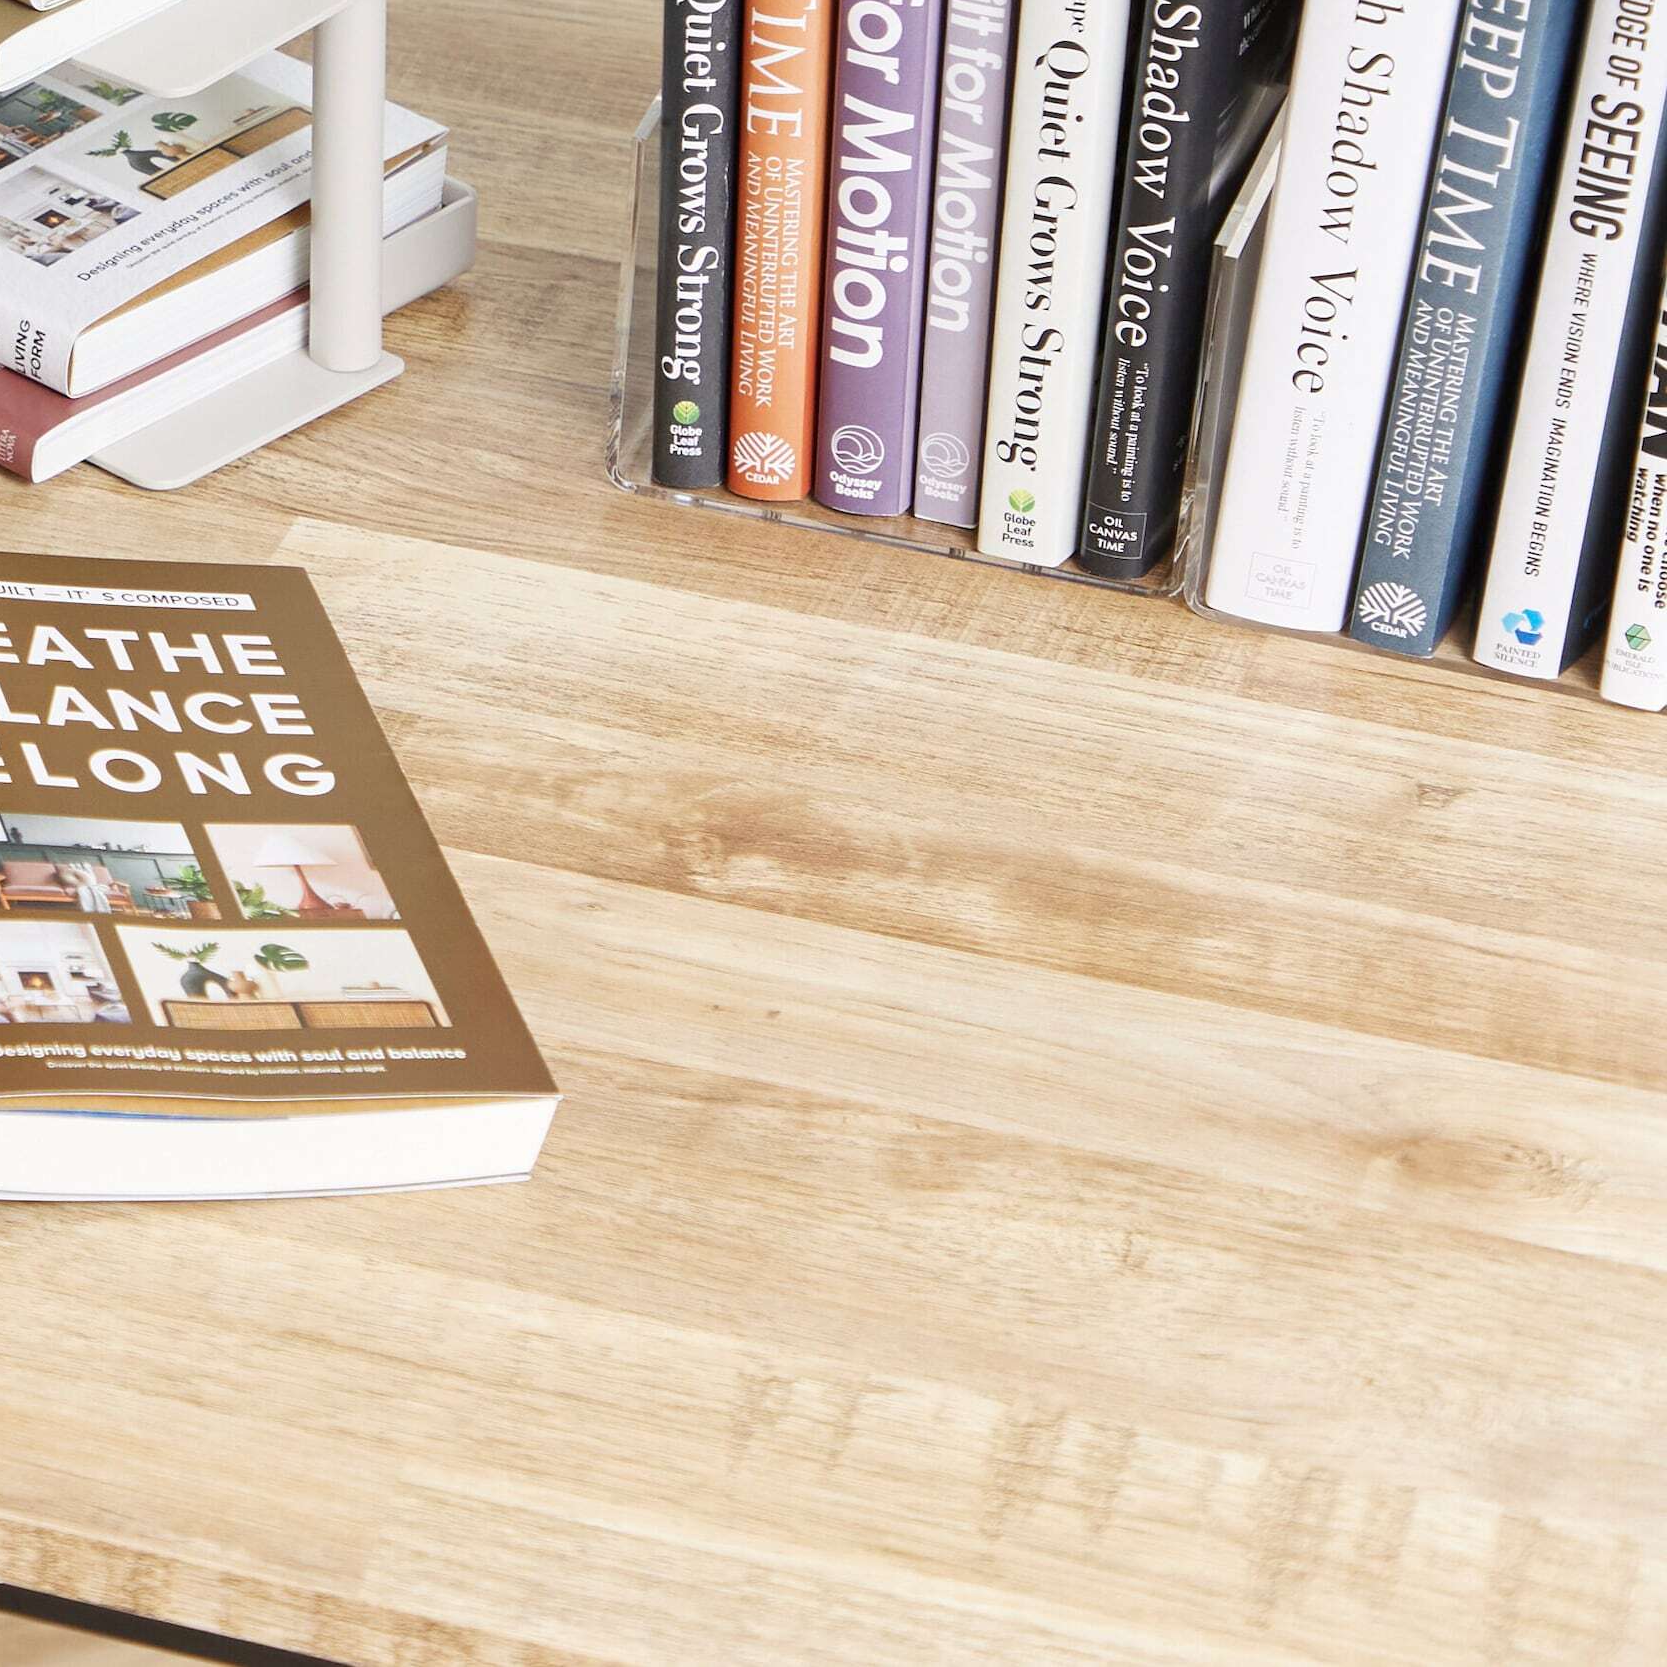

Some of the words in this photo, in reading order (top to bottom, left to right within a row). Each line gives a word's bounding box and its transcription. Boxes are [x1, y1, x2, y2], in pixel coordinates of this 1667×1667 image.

[942, 45, 1003, 126] for
[1606, 53, 1647, 92] OF
[1035, 40, 1092, 162] Quiet
[677, 102, 725, 233] Grows
[765, 156, 782, 182] OF
[1319, 44, 1398, 245] Shadow
[1570, 93, 1646, 242] SEEING
[747, 150, 762, 196] AND
[781, 158, 804, 267] MASTERING
[1418, 116, 1521, 295] TIME
[829, 93, 915, 368] Motion
[929, 129, 995, 333] Motion
[1025, 175, 1080, 312] Grows
[741, 199, 762, 324] MEANINGFUL
[758, 187, 782, 344] UNINTERRUPTED
[1116, 217, 1177, 348] Voice
[1573, 253, 1599, 309] WHERE
[780, 271, 797, 308] THE
[662, 245, 721, 386] Strong
[778, 312, 797, 349] ART
[1292, 267, 1360, 395] Voice
[1562, 311, 1589, 366] VISION
[15, 319, 31, 374] LIVING
[30, 330, 46, 379] FORM
[738, 331, 757, 397] LIVING
[755, 349, 776, 407] WORK
[997, 322, 1067, 472] Strong
[1554, 367, 1579, 410] ENDS
[670, 424, 702, 438] Globe
[670, 443, 702, 457] Press
[672, 434, 700, 447] Leaf
[745, 471, 779, 485] CEDAR
[830, 471, 882, 491] Odyssey
[1536, 417, 1569, 518] IMAGINATION
[835, 485, 875, 500] Books
[1626, 467, 1648, 543] watching
[1650, 473, 1667, 520] when
[1002, 533, 1035, 548] Press
[1004, 512, 1036, 527] Globe
[1006, 523, 1032, 537] Leaf
[1089, 523, 1138, 542] CANVAS
[1103, 515, 1124, 529] OIL
[1647, 521, 1658, 543] no
[1097, 538, 1125, 554] TIME
[1524, 520, 1551, 579] BEGINS
[1640, 545, 1655, 575] one
[1638, 575, 1649, 593] is
[1371, 621, 1408, 639] CEDAR
[90, 1044, 181, 1063] everyday
[184, 1049, 253, 1064] spaces
[255, 1048, 297, 1063] with
[301, 1048, 344, 1062] soul
[346, 1047, 385, 1062] and
[388, 1046, 467, 1061] balance
